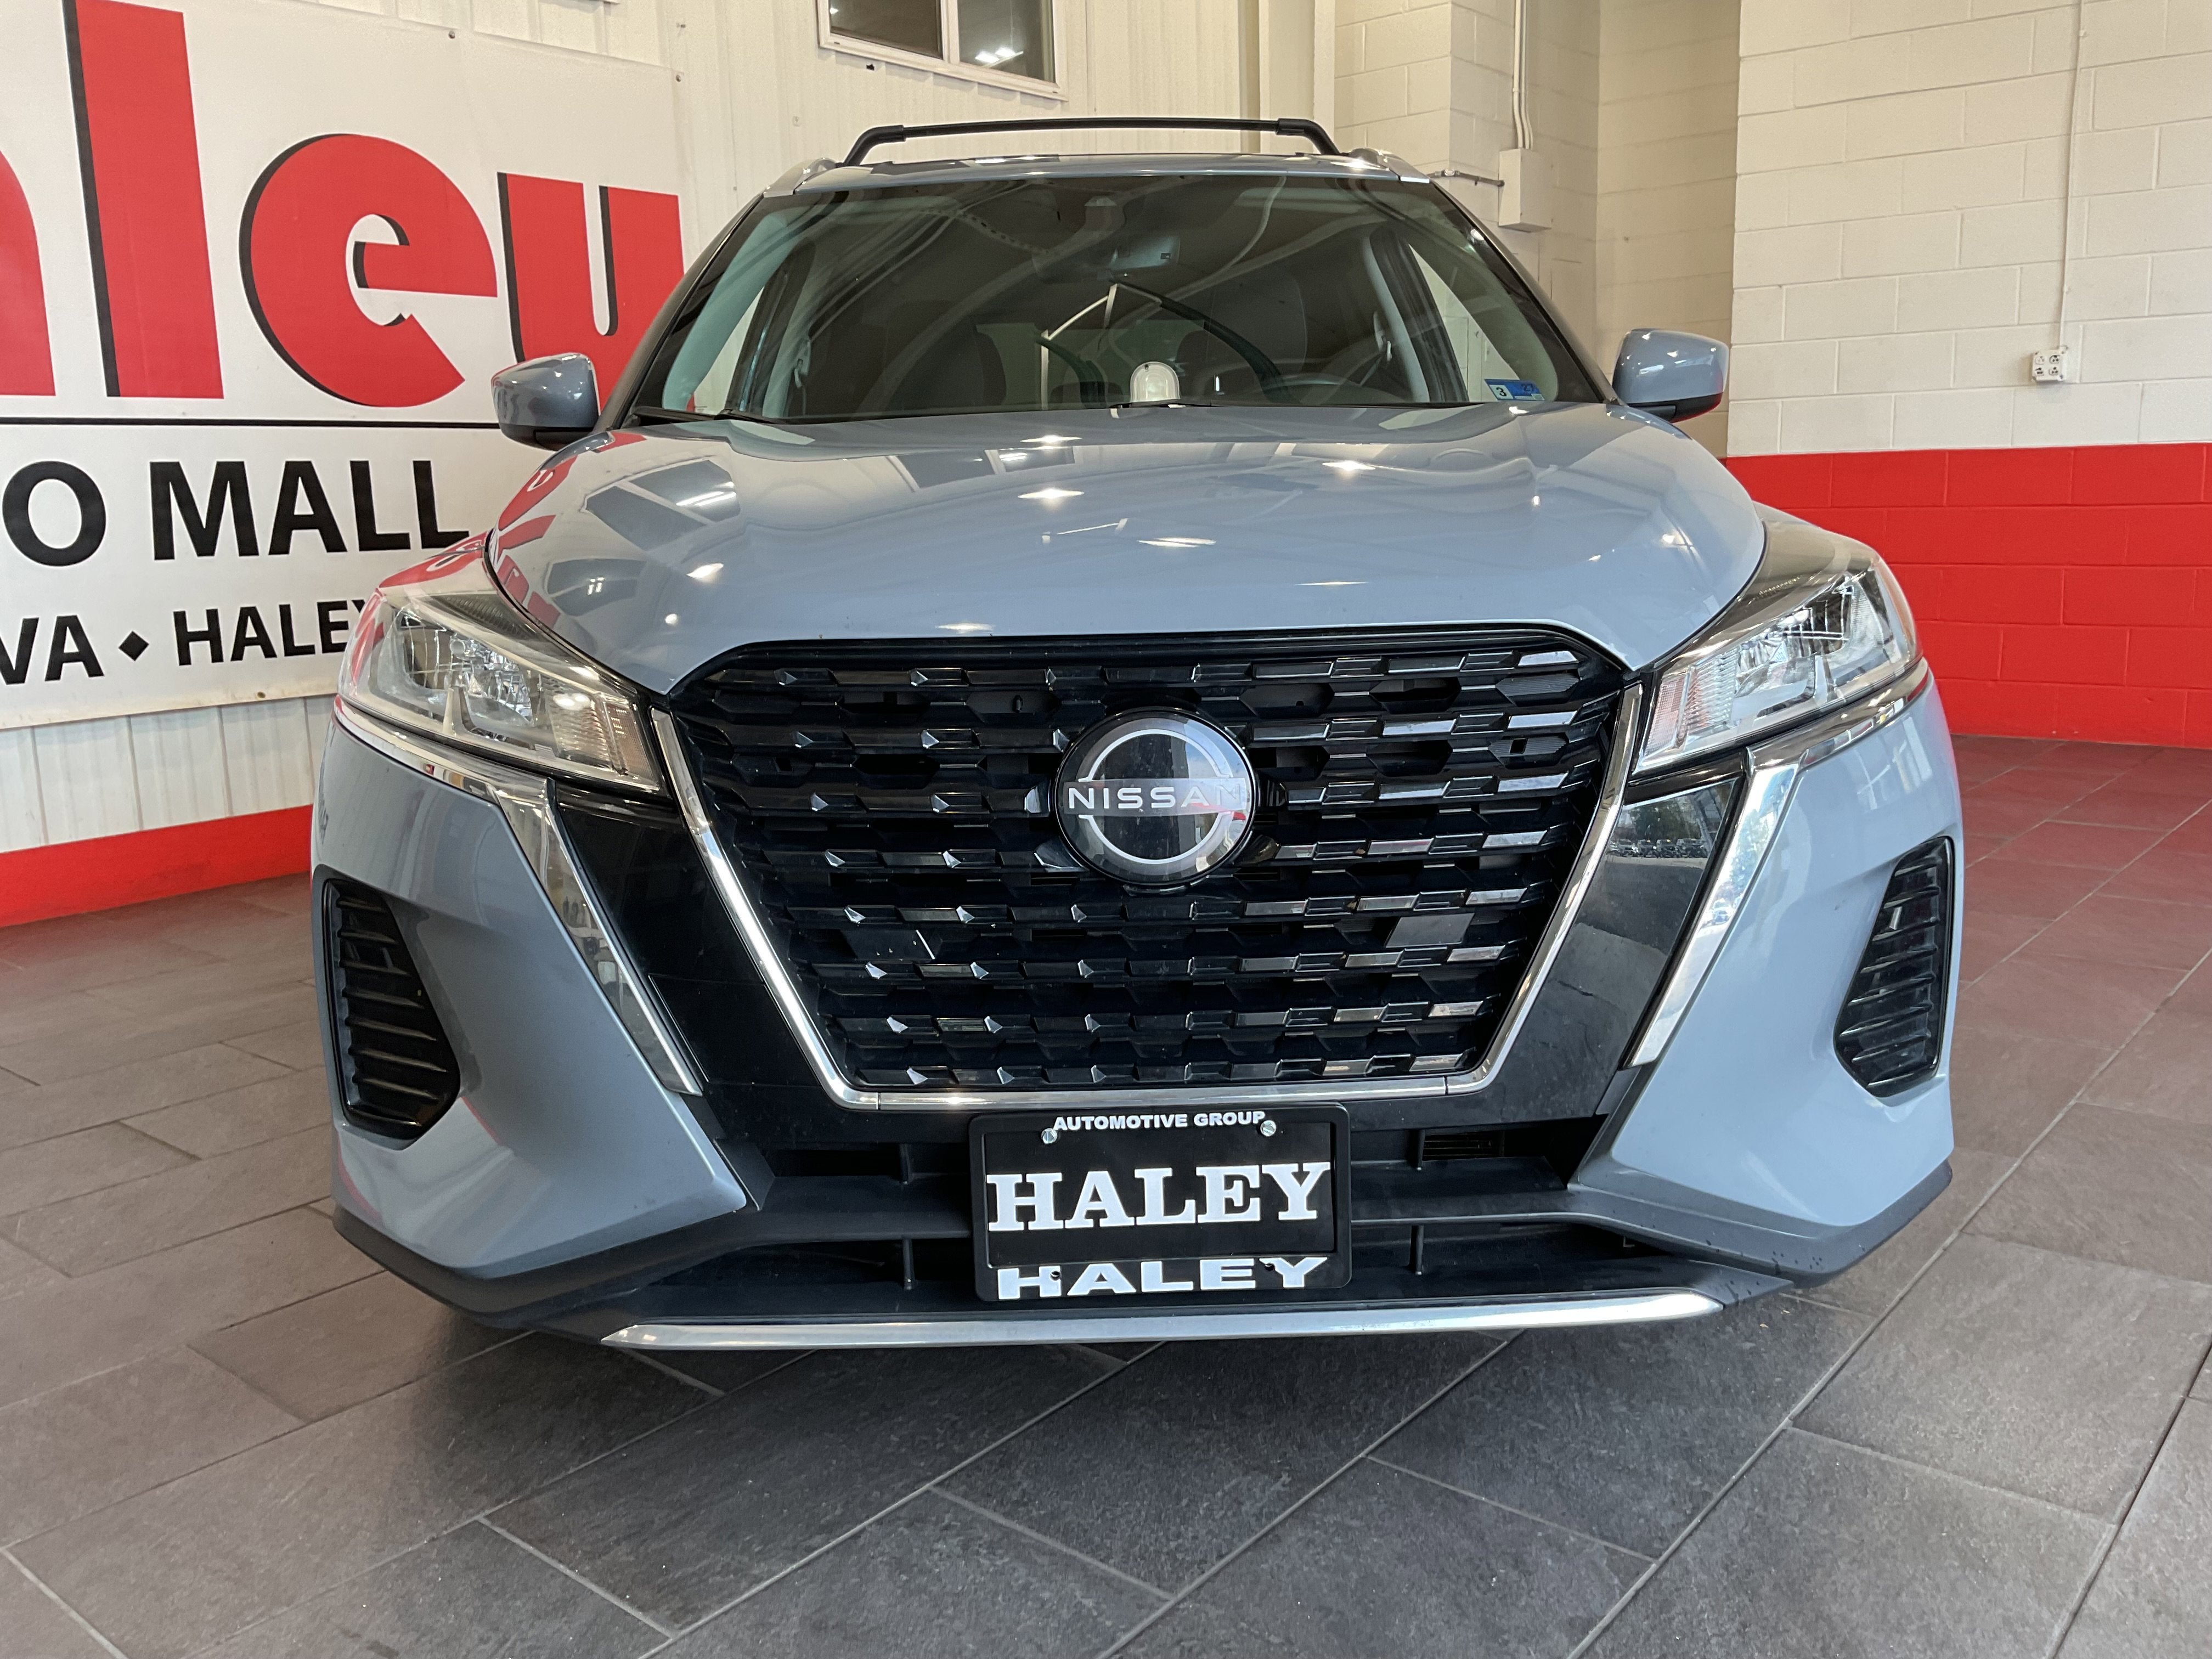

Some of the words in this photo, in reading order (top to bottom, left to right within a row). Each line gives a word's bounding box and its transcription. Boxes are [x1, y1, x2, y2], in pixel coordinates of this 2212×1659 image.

[0, 0, 684, 415] ley
[1496, 387, 1507, 397] 3
[2, 460, 106, 567] O
[149, 460, 470, 562] MALL
[173, 599, 366, 666] HALE
[1068, 783, 1241, 809] NISSAN
[1053, 1113, 1188, 1131] AUTOMOTIVE
[1193, 1110, 1266, 1127] GROUP
[986, 1161, 1331, 1231] HALEY
[997, 1257, 1328, 1300] HALEY
